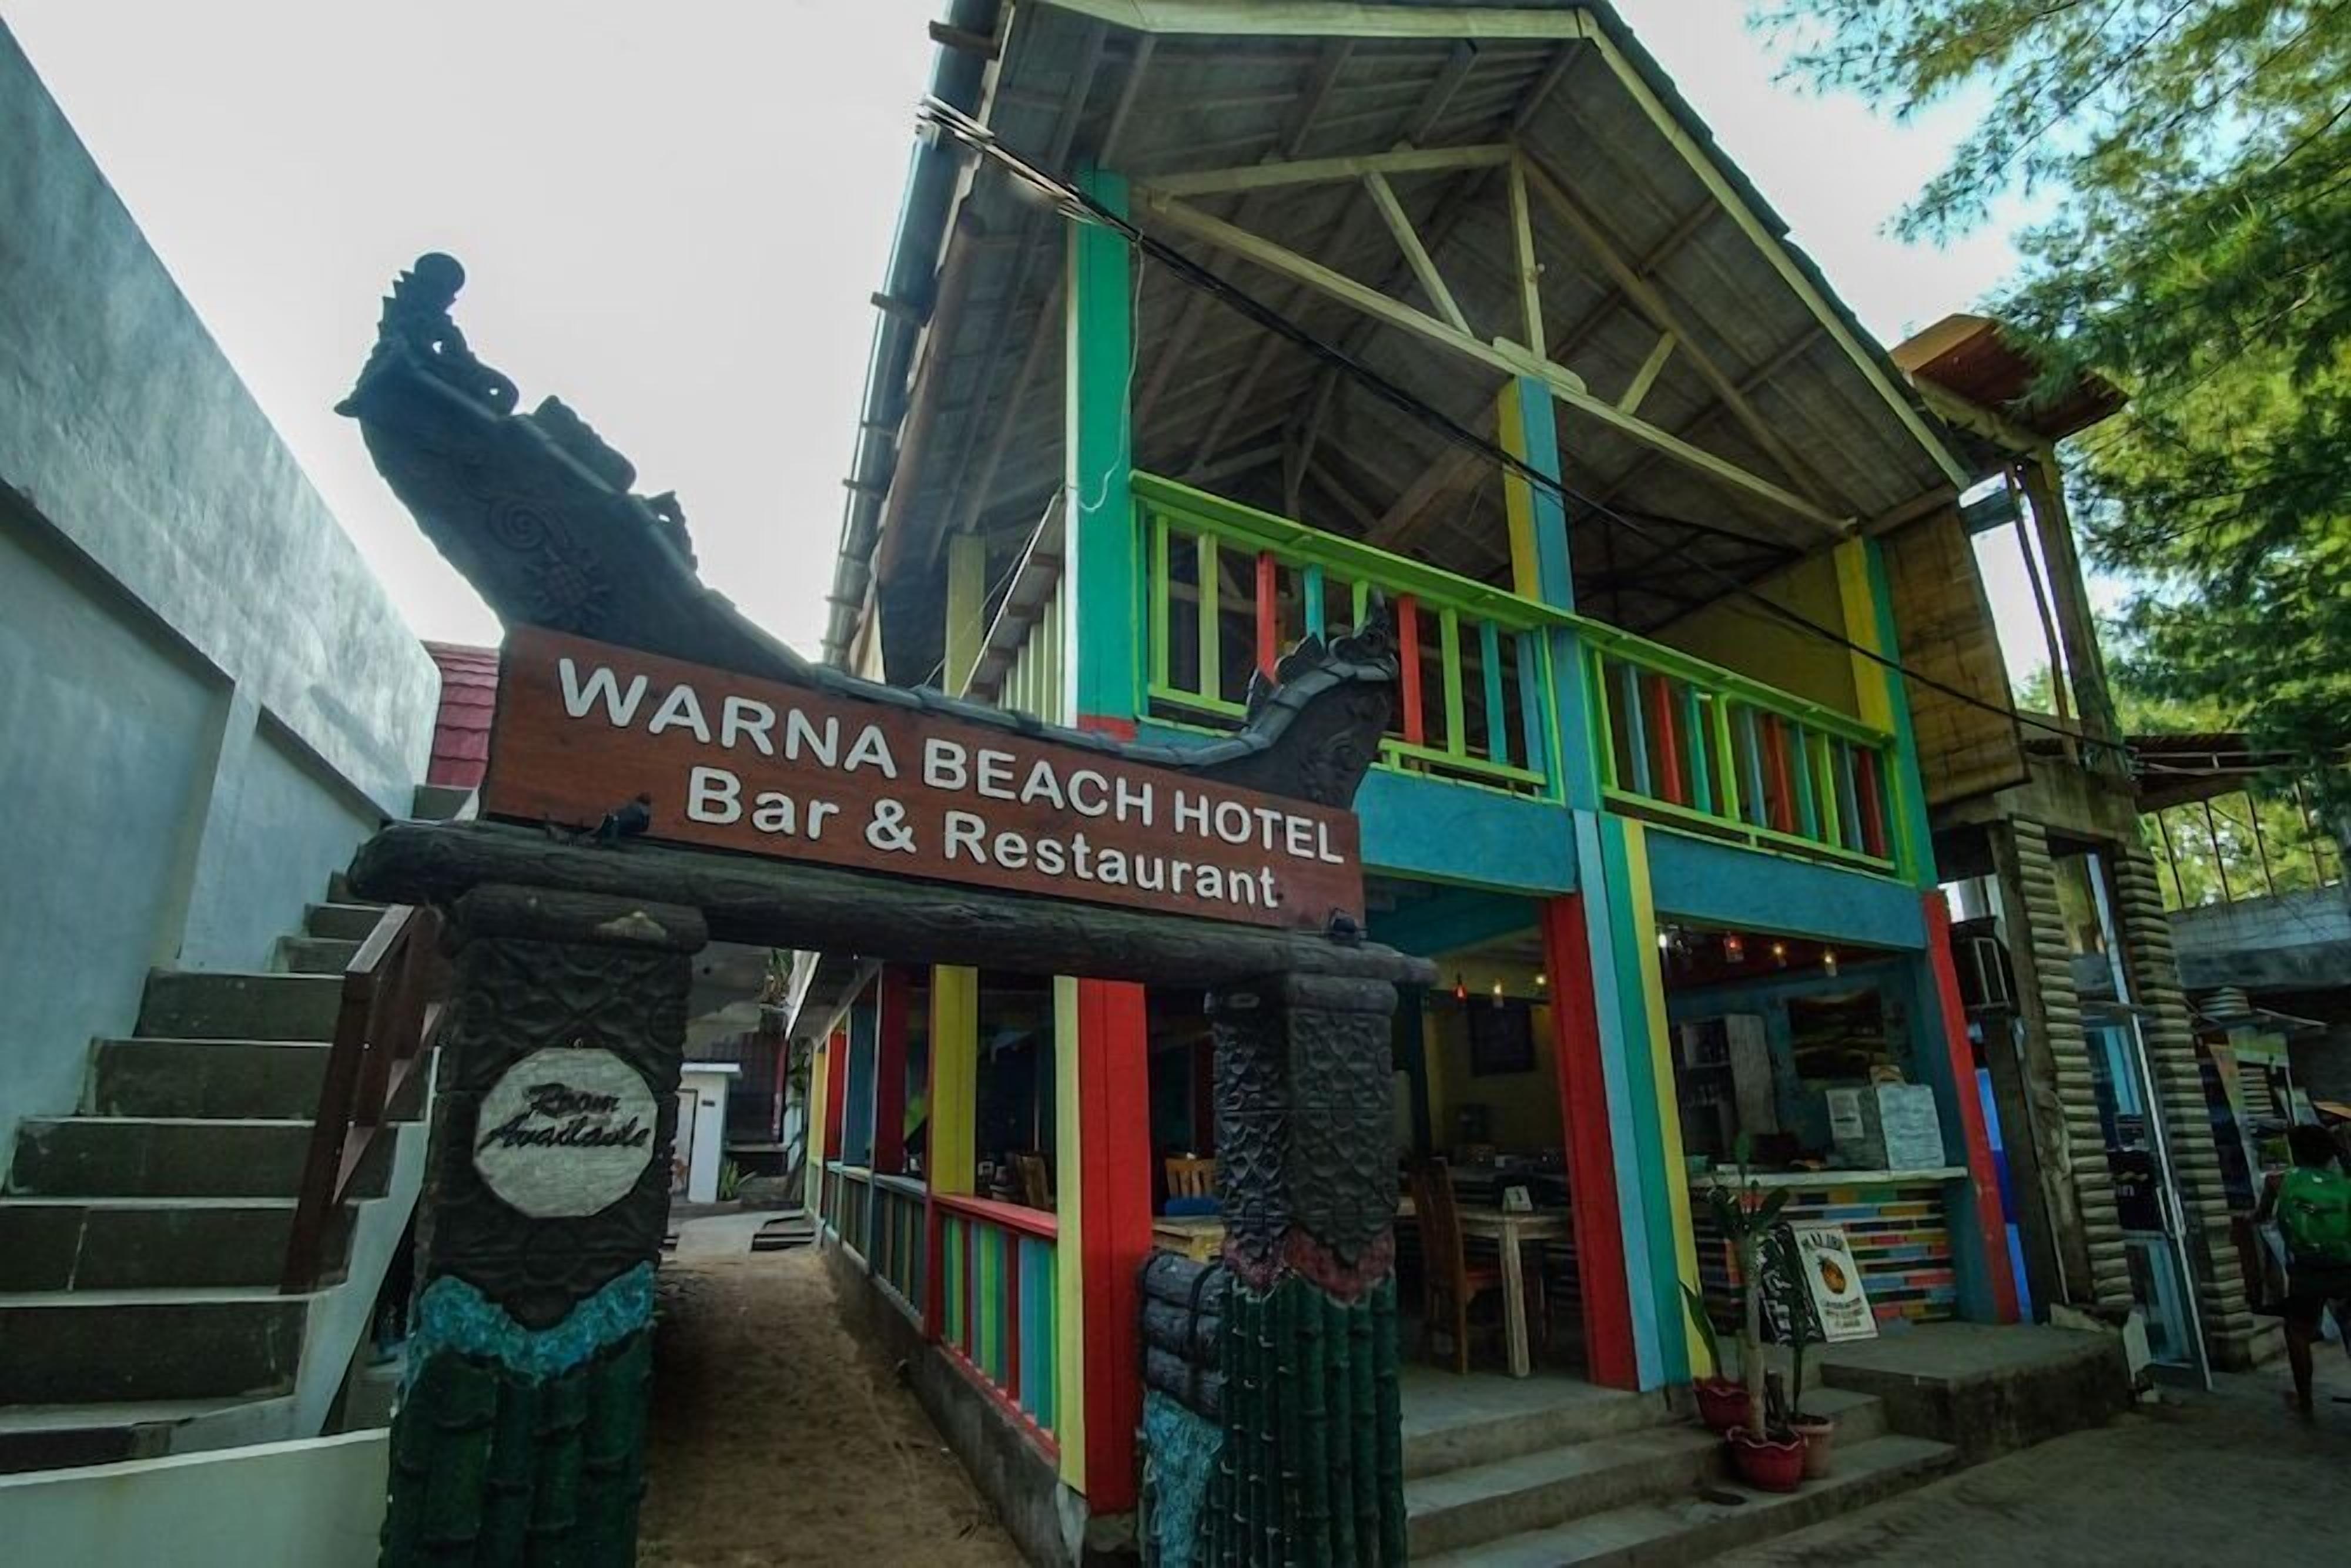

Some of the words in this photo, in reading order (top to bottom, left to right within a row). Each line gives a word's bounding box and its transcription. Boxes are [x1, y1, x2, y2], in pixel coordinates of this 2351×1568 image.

[558, 657, 897, 780] WARNA
[923, 737, 1154, 826] BEACH
[1174, 789, 1344, 865] HOTEL
[686, 766, 840, 840] Bar
[865, 798, 917, 854] &
[944, 810, 1280, 909] Restaurant
